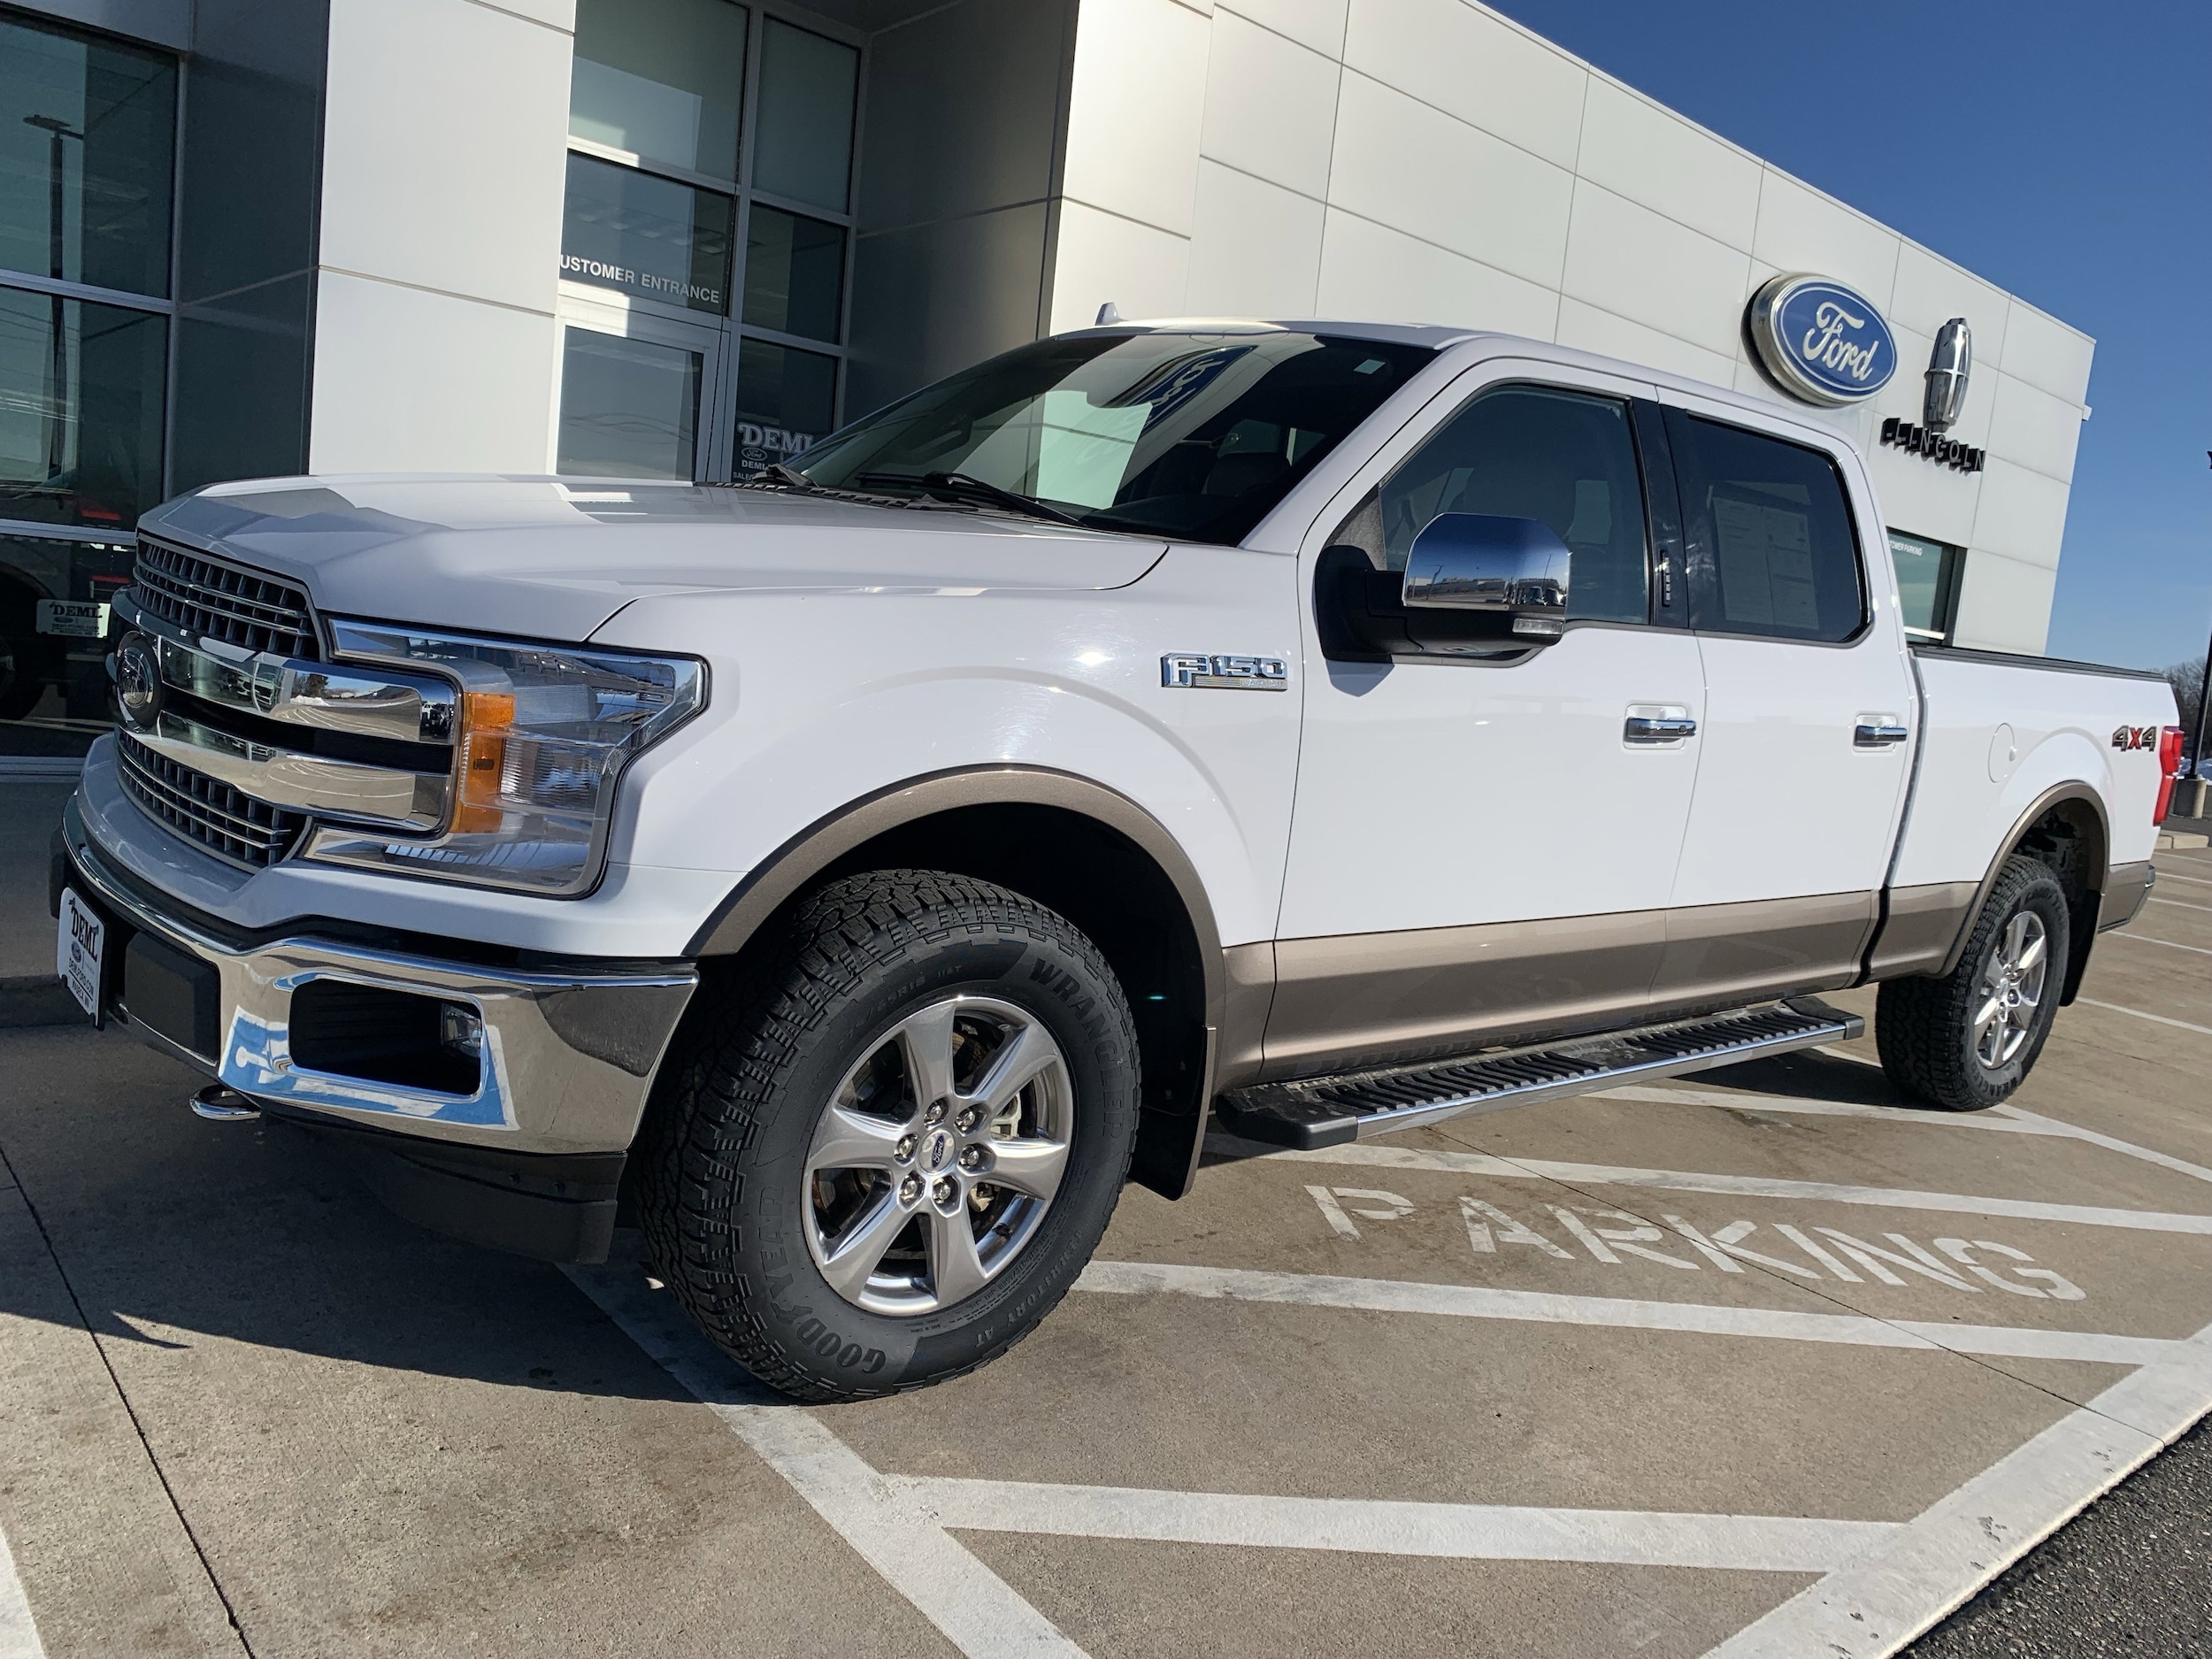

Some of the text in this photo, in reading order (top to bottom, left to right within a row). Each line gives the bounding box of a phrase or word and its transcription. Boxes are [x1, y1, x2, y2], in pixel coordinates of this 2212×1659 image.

[560, 254, 719, 304] USTOMER ENTRANCE
[1801, 301, 1880, 382] Ford
[1880, 417, 1985, 472] LINCOLN
[50, 604, 103, 618] DEML
[71, 906, 98, 963] DEML
[1029, 957, 1125, 1139] WRANGLER
[1303, 1185, 2087, 1301] PARKING
[975, 1230, 1082, 1348] TERRITORY AT
